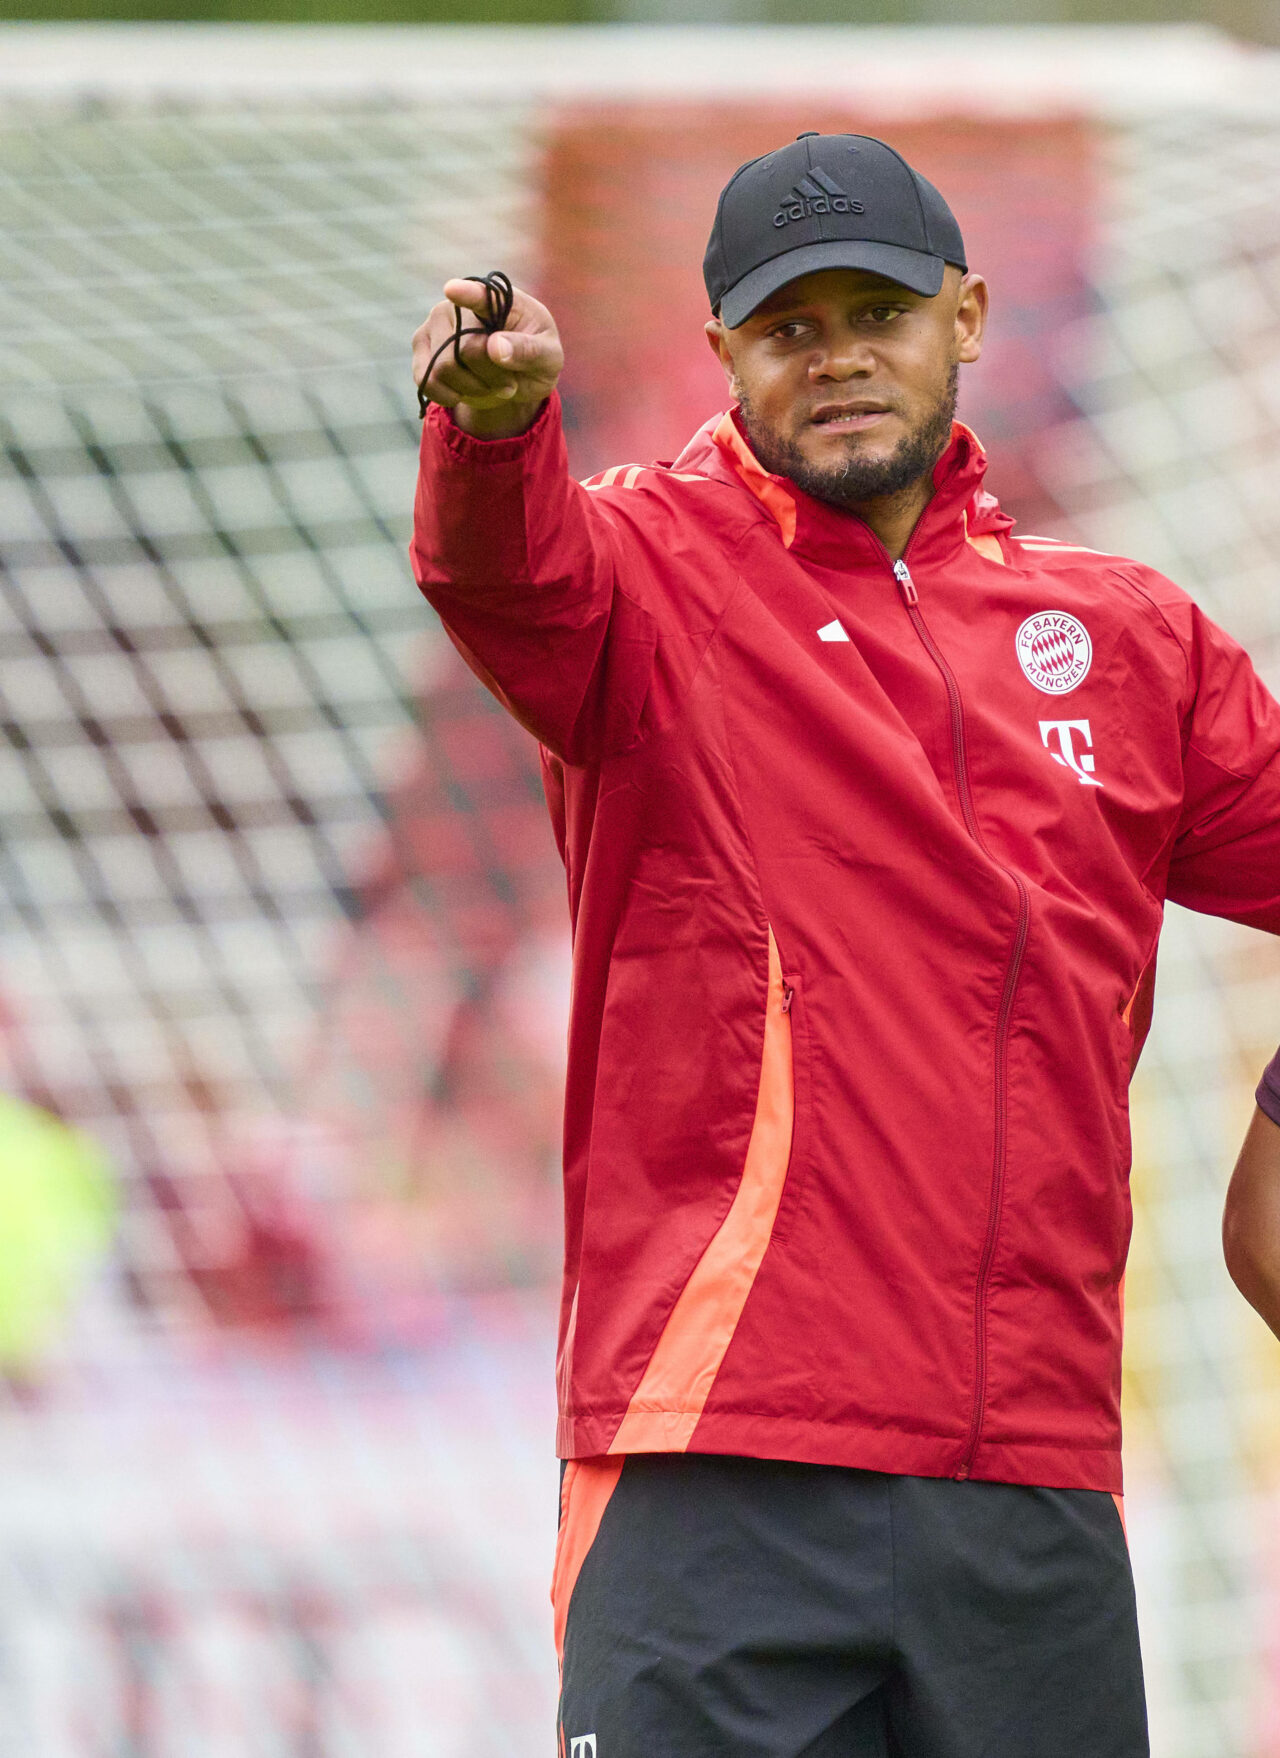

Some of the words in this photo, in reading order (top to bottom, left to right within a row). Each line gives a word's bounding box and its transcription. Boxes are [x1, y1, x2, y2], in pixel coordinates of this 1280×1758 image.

[773, 195, 864, 228] adidas
[1021, 630, 1033, 648] FC
[1033, 617, 1084, 645] BAYERN
[1038, 719, 1104, 787] T
